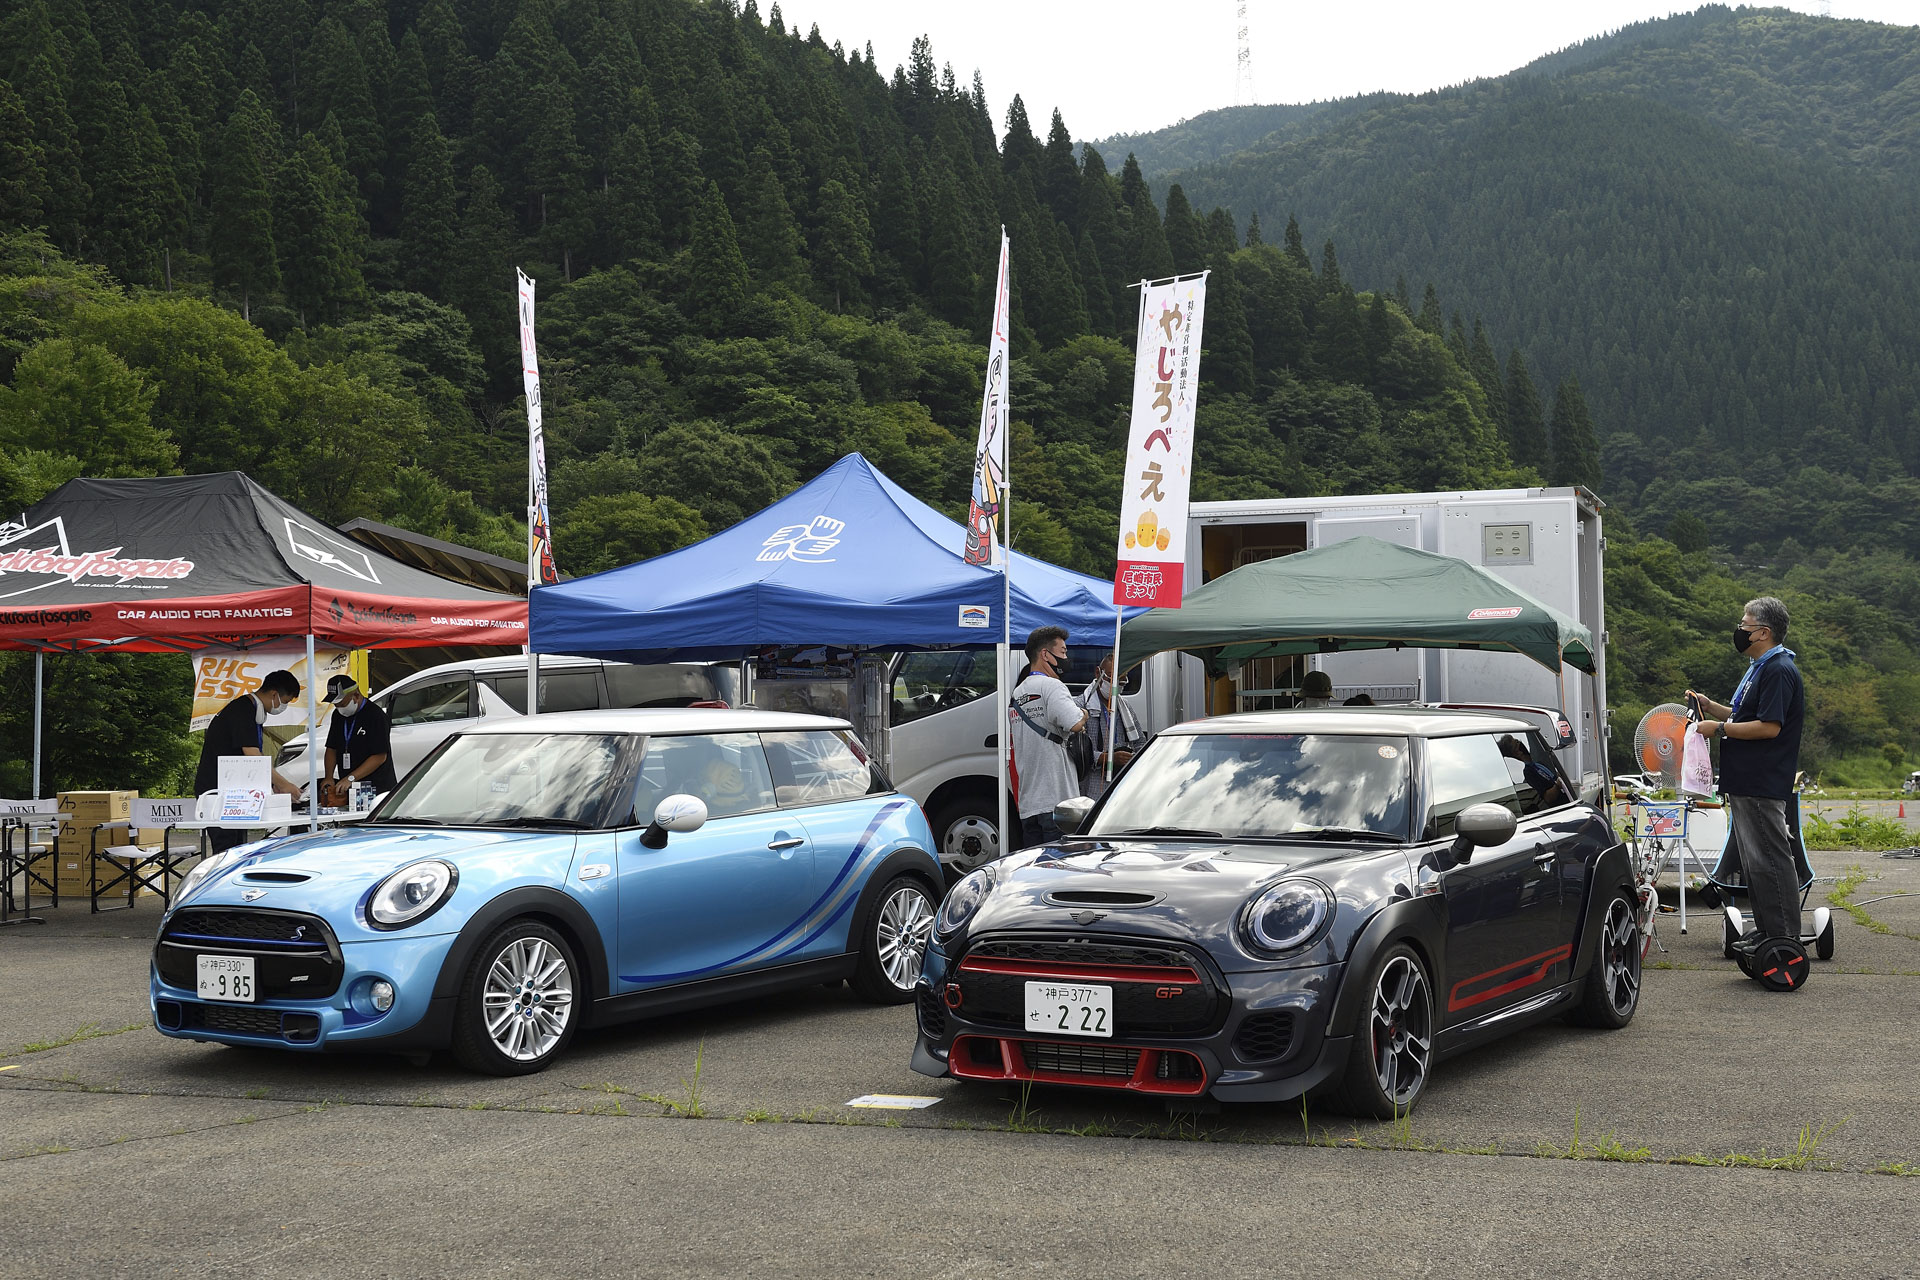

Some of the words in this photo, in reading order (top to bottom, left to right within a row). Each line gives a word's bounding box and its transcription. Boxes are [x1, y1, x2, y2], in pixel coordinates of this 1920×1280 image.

[1140, 303, 1183, 503] やじろべえ
[0, 545, 89, 575] ckford
[1122, 571, 1163, 586] 尼崎市民
[1126, 584, 1157, 600] まつり
[0, 609, 39, 625] ckford
[117, 610, 146, 619] CAR
[149, 610, 191, 619] AUDIO
[194, 609, 221, 619] FOR
[225, 607, 293, 618] FANATICS
[430, 616, 449, 625] CAR
[450, 617, 474, 627] AUDIO
[475, 619, 490, 628] FOR
[490, 620, 525, 629] FANATICS
[200, 657, 259, 681] RHC
[151, 804, 183, 816] MINI
[1155, 987, 1183, 998] GP
[1030, 1010, 1040, 1021] せ
